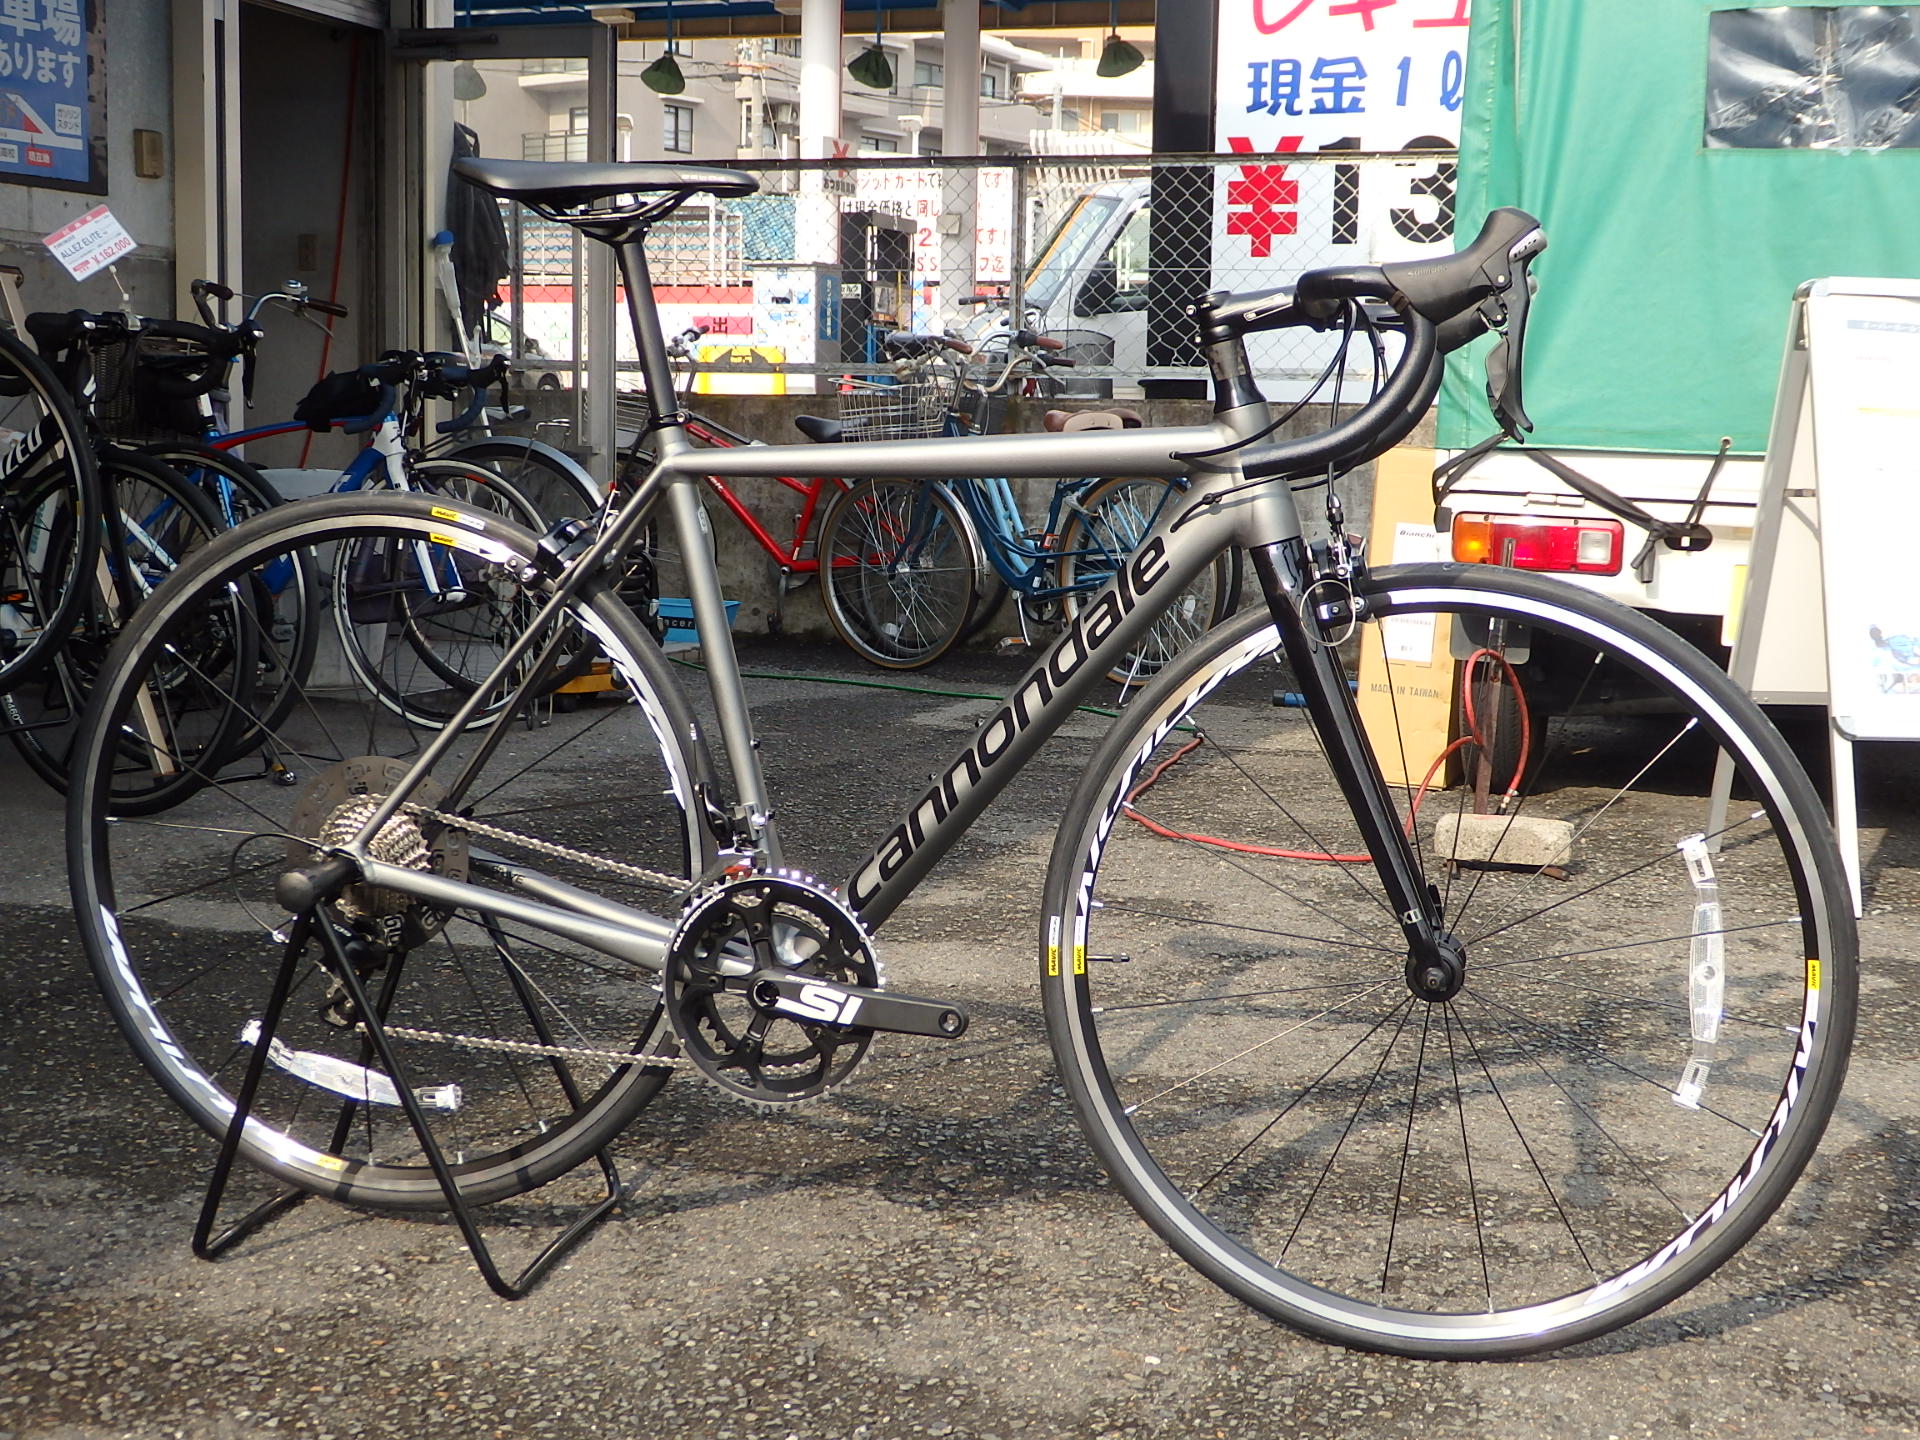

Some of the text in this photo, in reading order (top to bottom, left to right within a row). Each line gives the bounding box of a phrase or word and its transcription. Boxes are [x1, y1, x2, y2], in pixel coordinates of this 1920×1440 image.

[1246, 56, 1368, 116] 現金
[60, 241, 84, 260] ALLEZ
[81, 230, 103, 247] ELITE
[712, 317, 728, 334] 出
[1399, 529, 1435, 539] Bianchi
[1396, 685, 1405, 695] IN
[1409, 686, 1439, 699] TAIWAN
[847, 535, 1170, 904] cannondale
[774, 984, 864, 1025] SI
